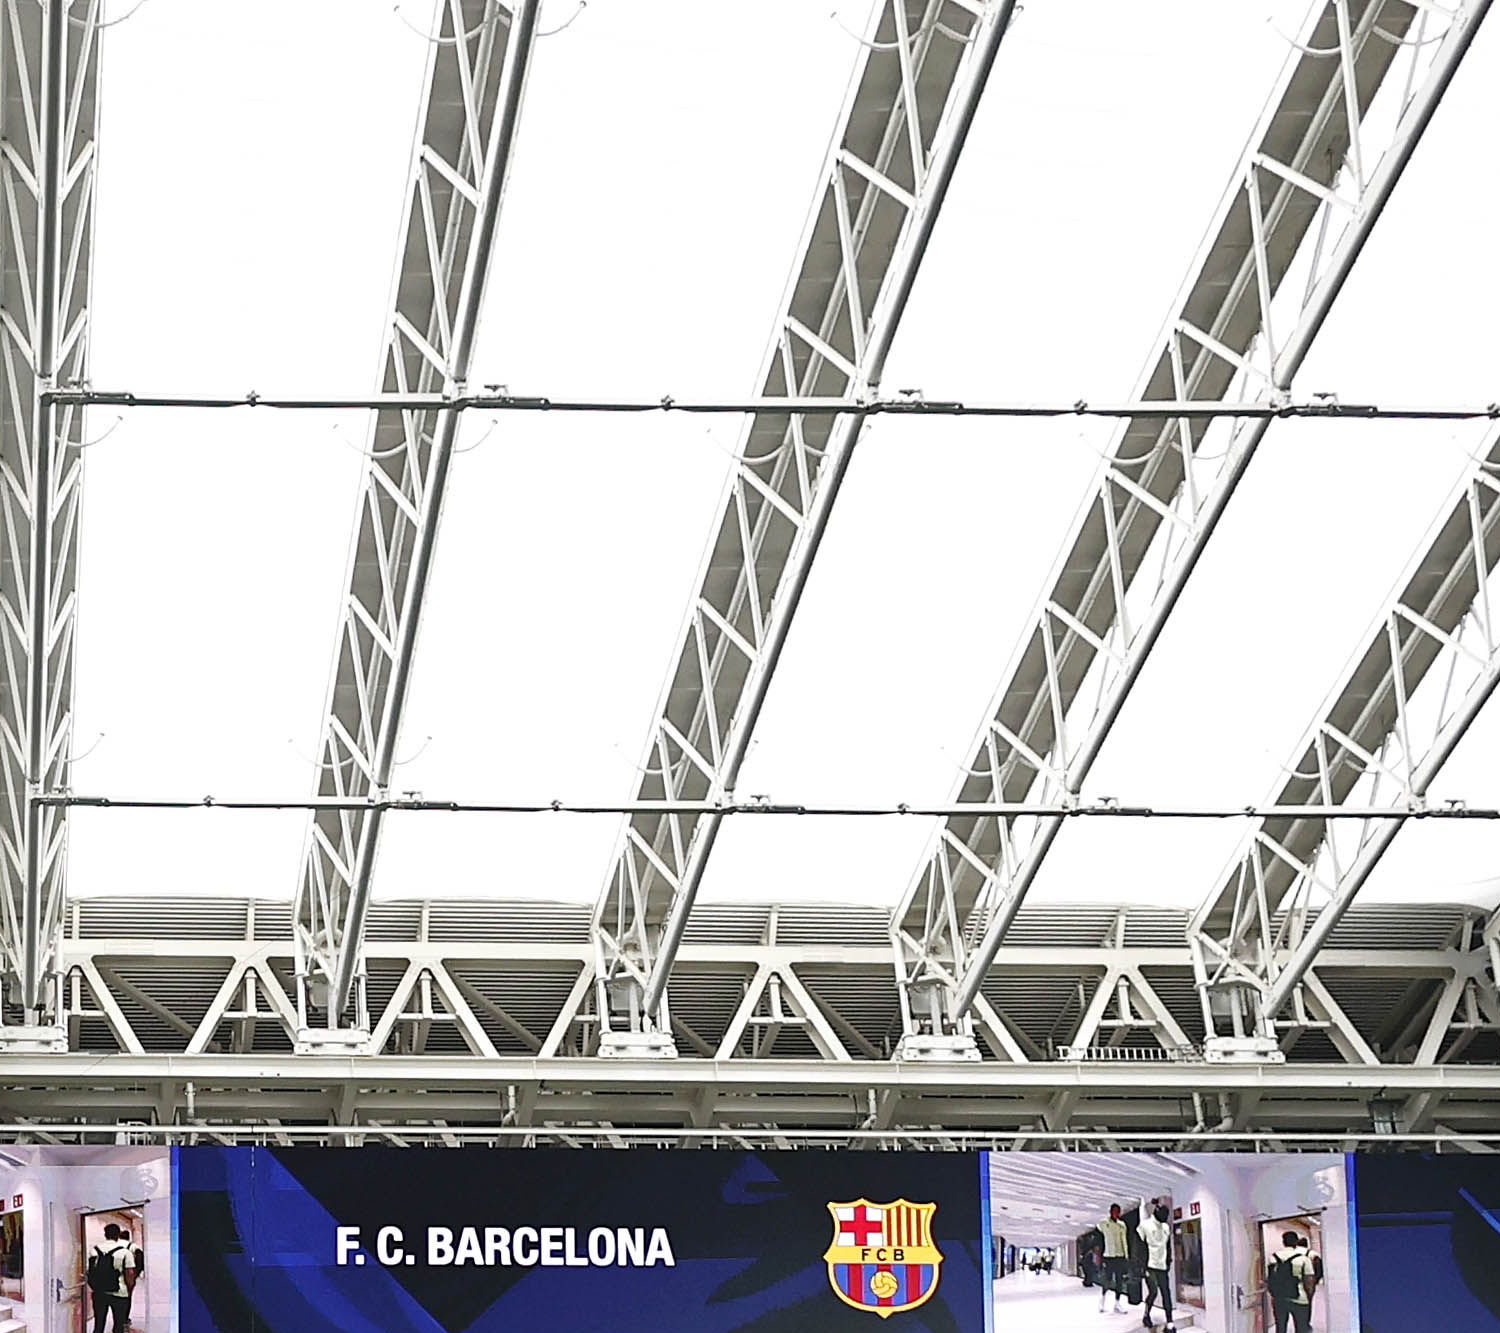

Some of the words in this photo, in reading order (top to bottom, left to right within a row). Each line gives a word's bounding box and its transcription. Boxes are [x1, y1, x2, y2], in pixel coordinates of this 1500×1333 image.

[335, 1225, 364, 1266] F.
[376, 1224, 413, 1266] C.
[427, 1225, 675, 1267] BARCELONA
